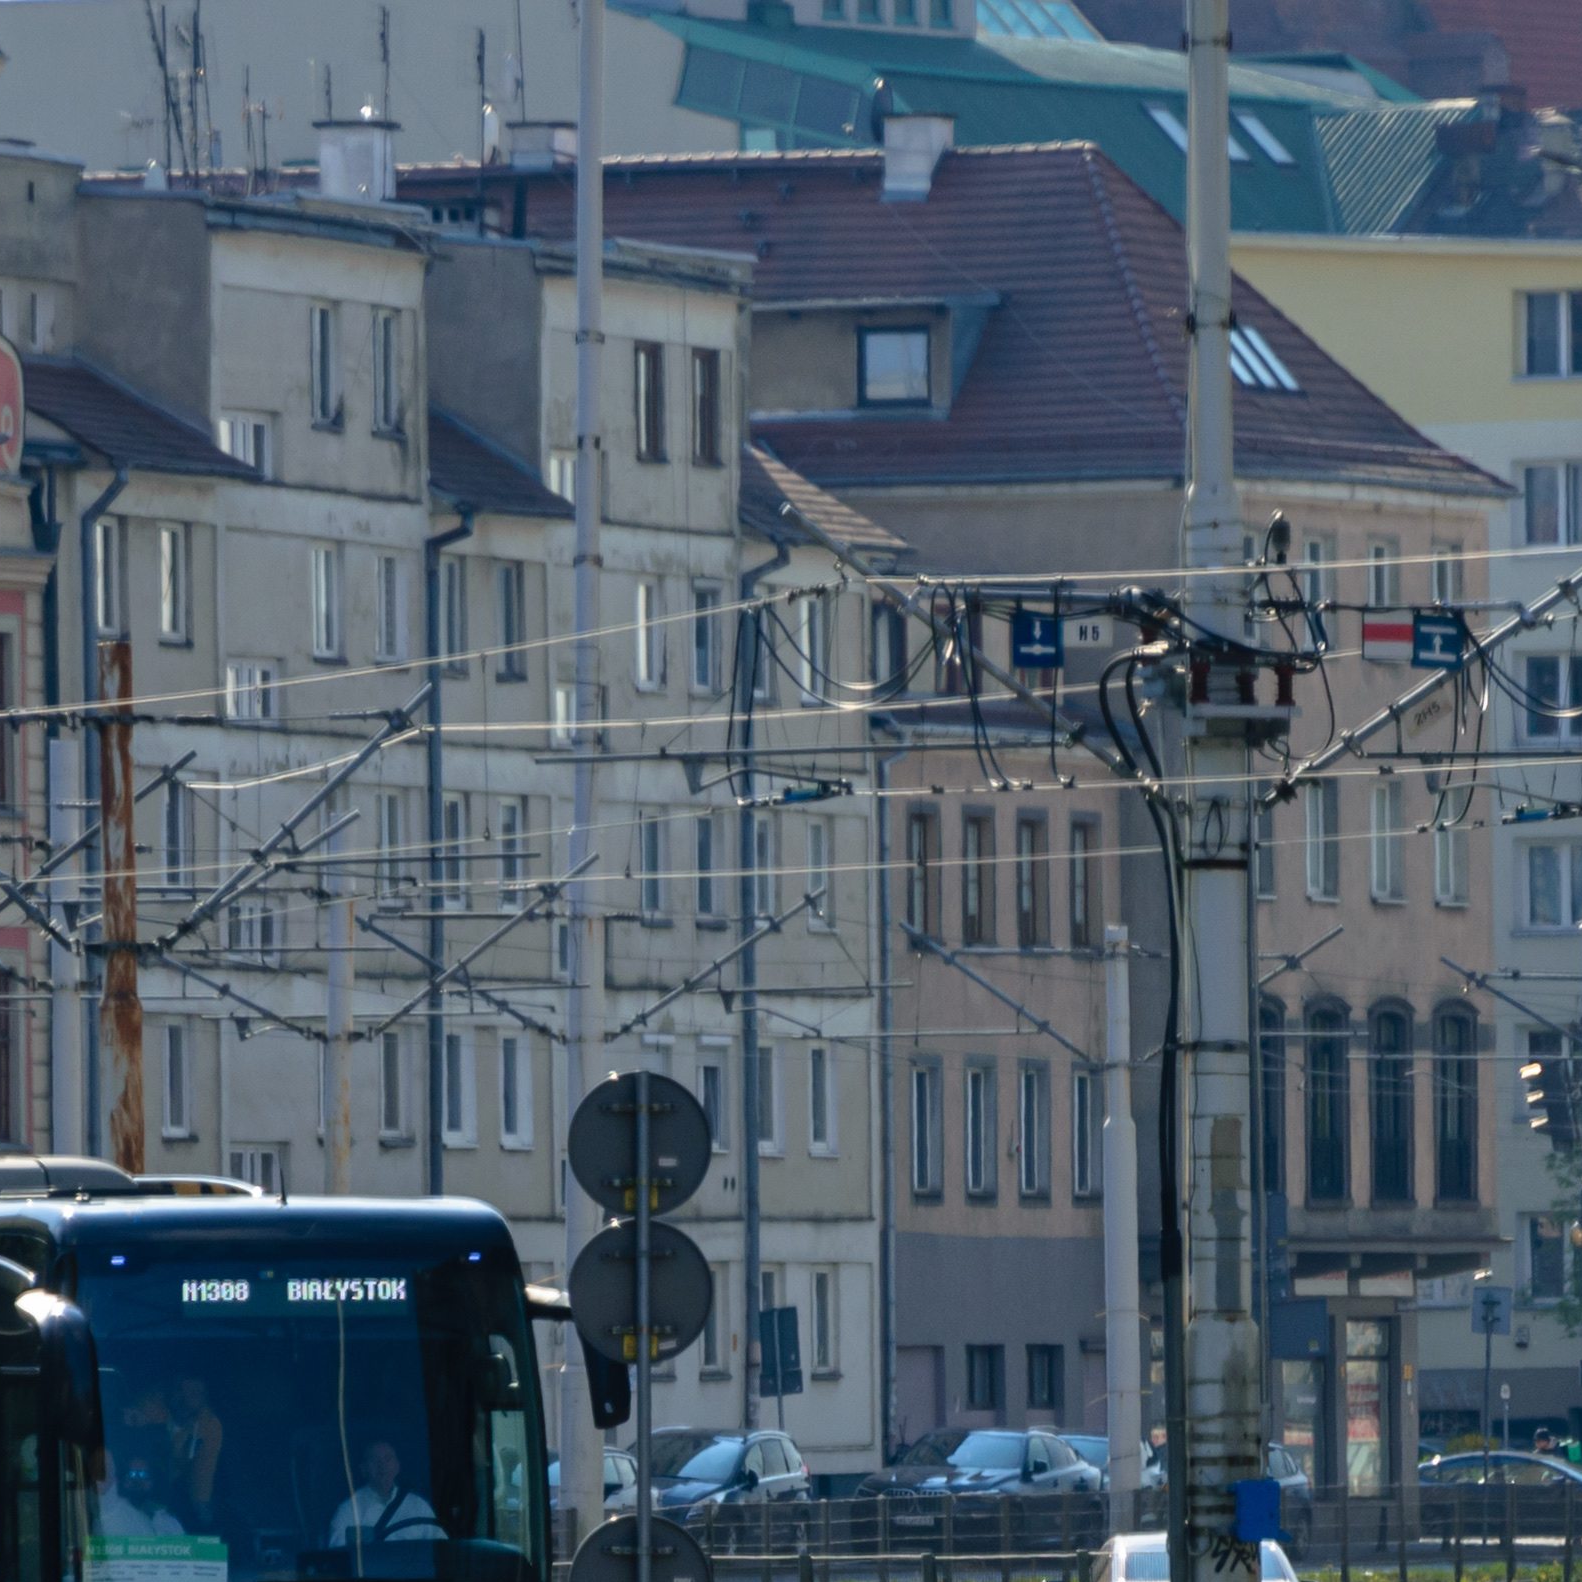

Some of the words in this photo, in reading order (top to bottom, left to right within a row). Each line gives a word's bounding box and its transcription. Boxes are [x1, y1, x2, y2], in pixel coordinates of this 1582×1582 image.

[182, 1280, 250, 1302] N1308
[287, 1279, 407, 1301] BIAŁYSTOK
[127, 1544, 191, 1557] BIAŁYSTOK
